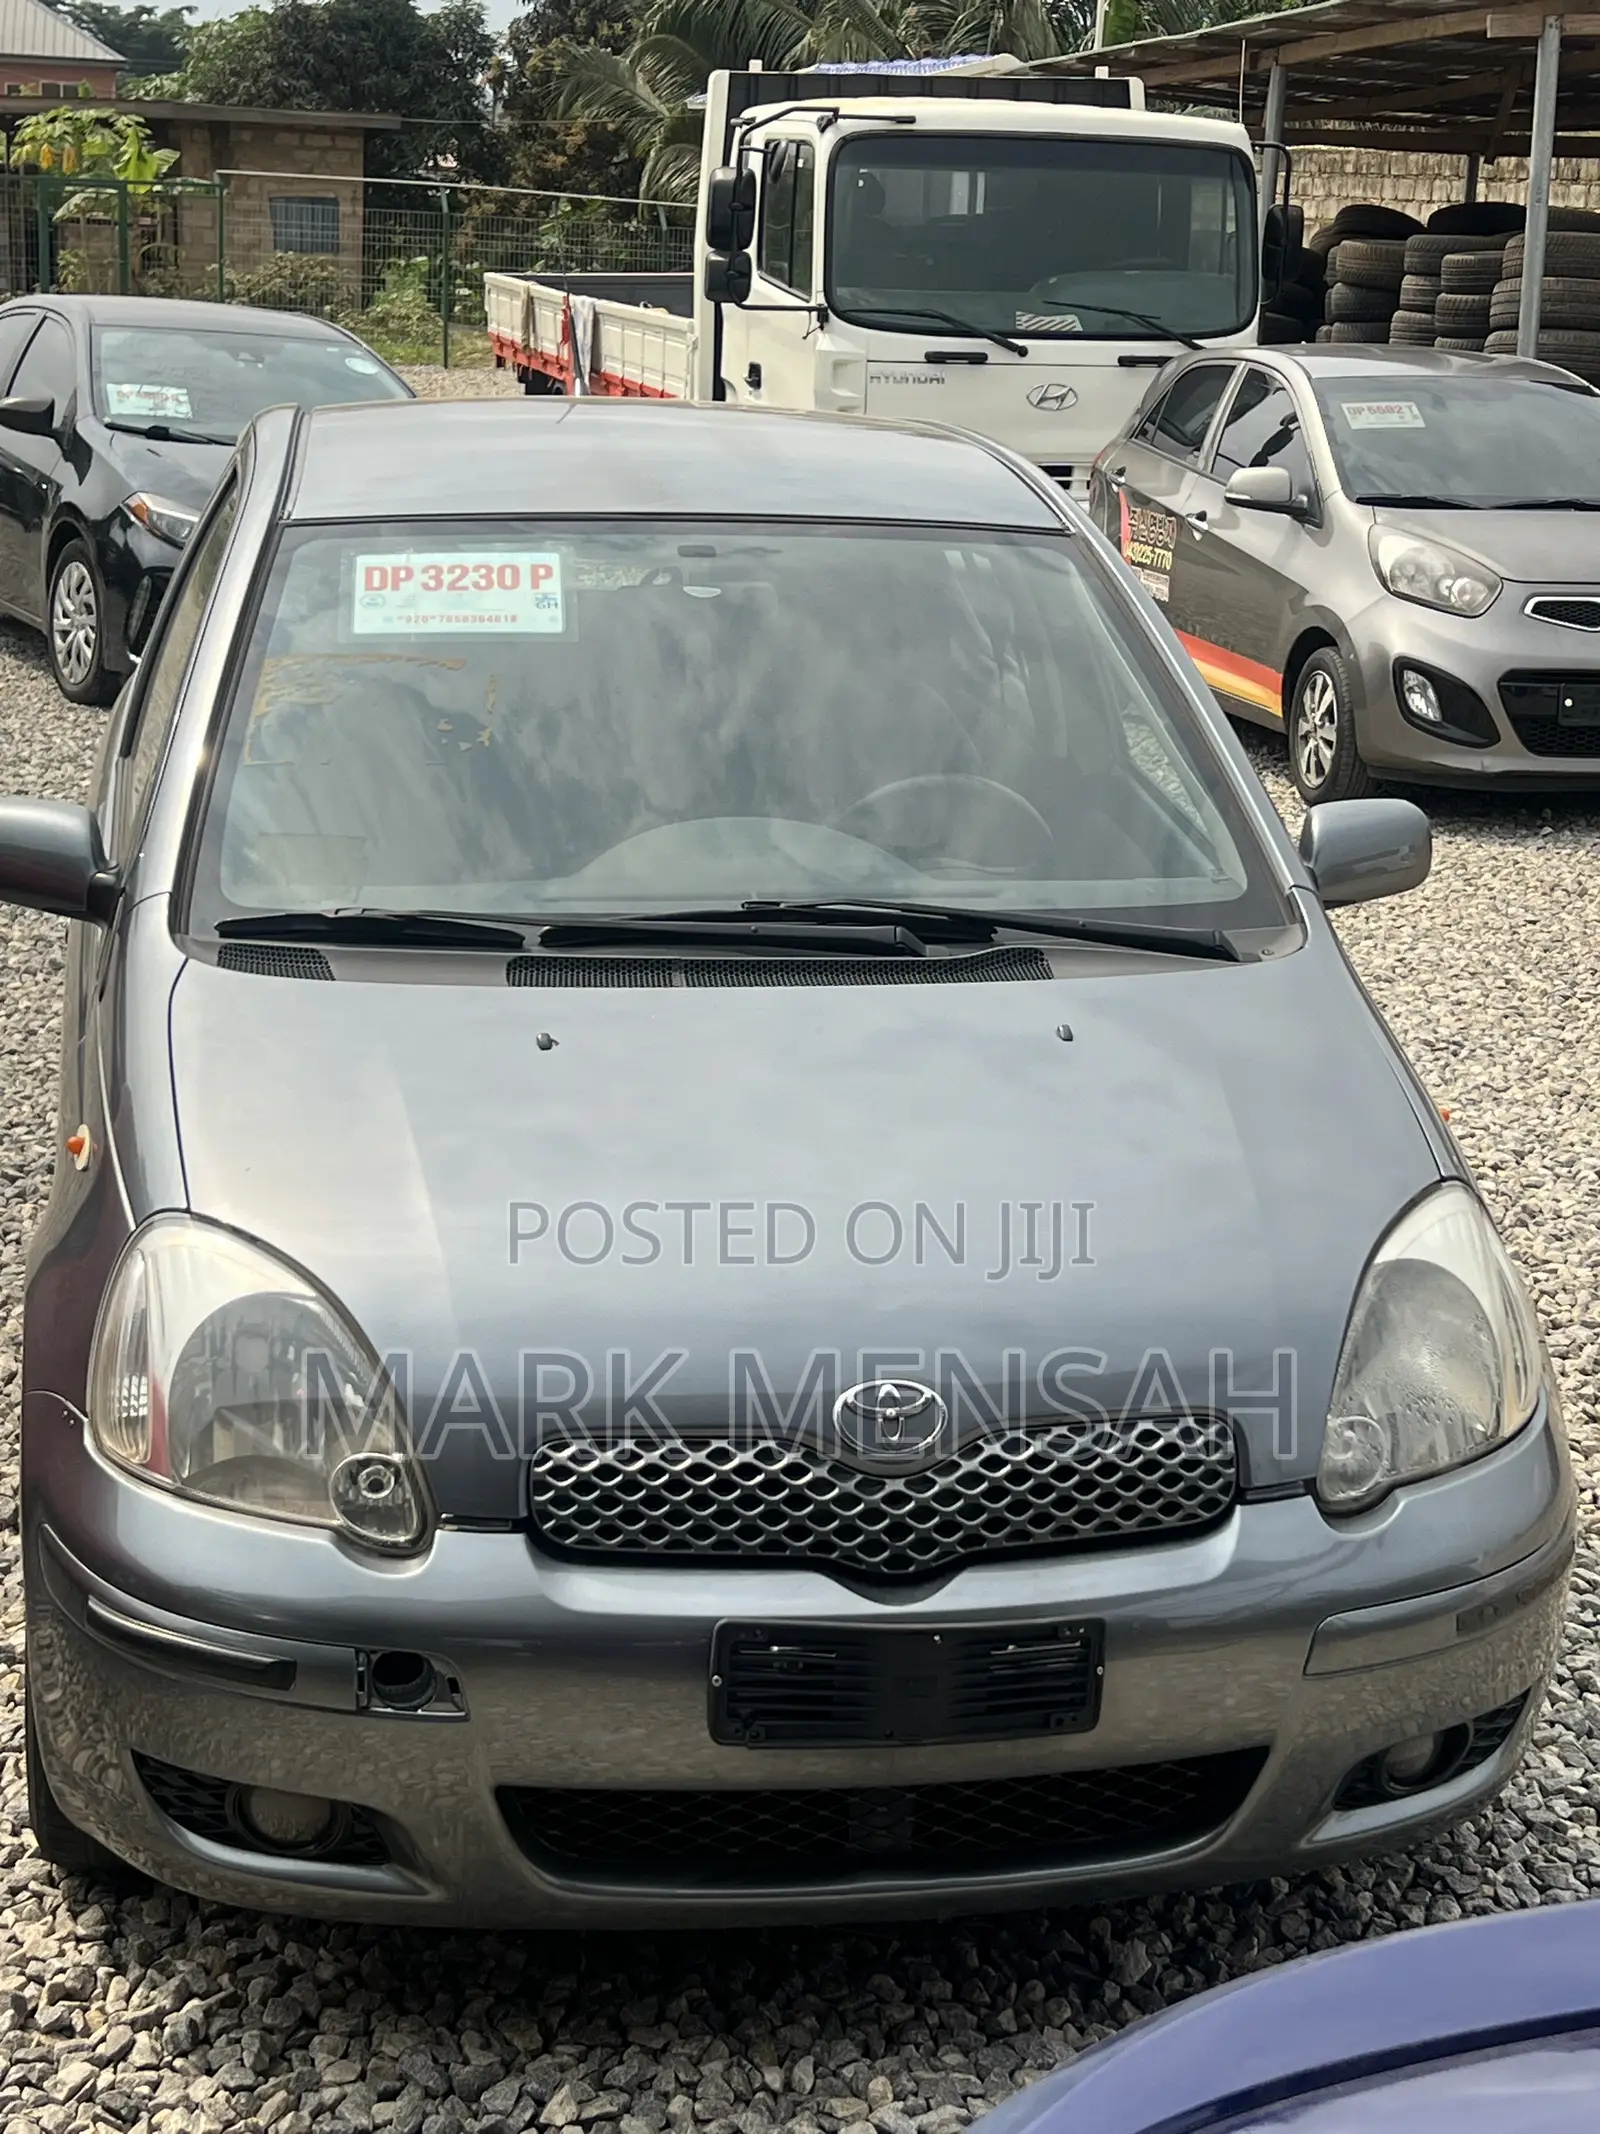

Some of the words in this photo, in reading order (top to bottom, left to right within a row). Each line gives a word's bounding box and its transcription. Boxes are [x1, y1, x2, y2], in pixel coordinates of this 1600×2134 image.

[869, 371, 945, 385] HYUNDAI
[364, 566, 414, 591] DP
[421, 564, 521, 591] 3230
[530, 564, 554, 590] P
